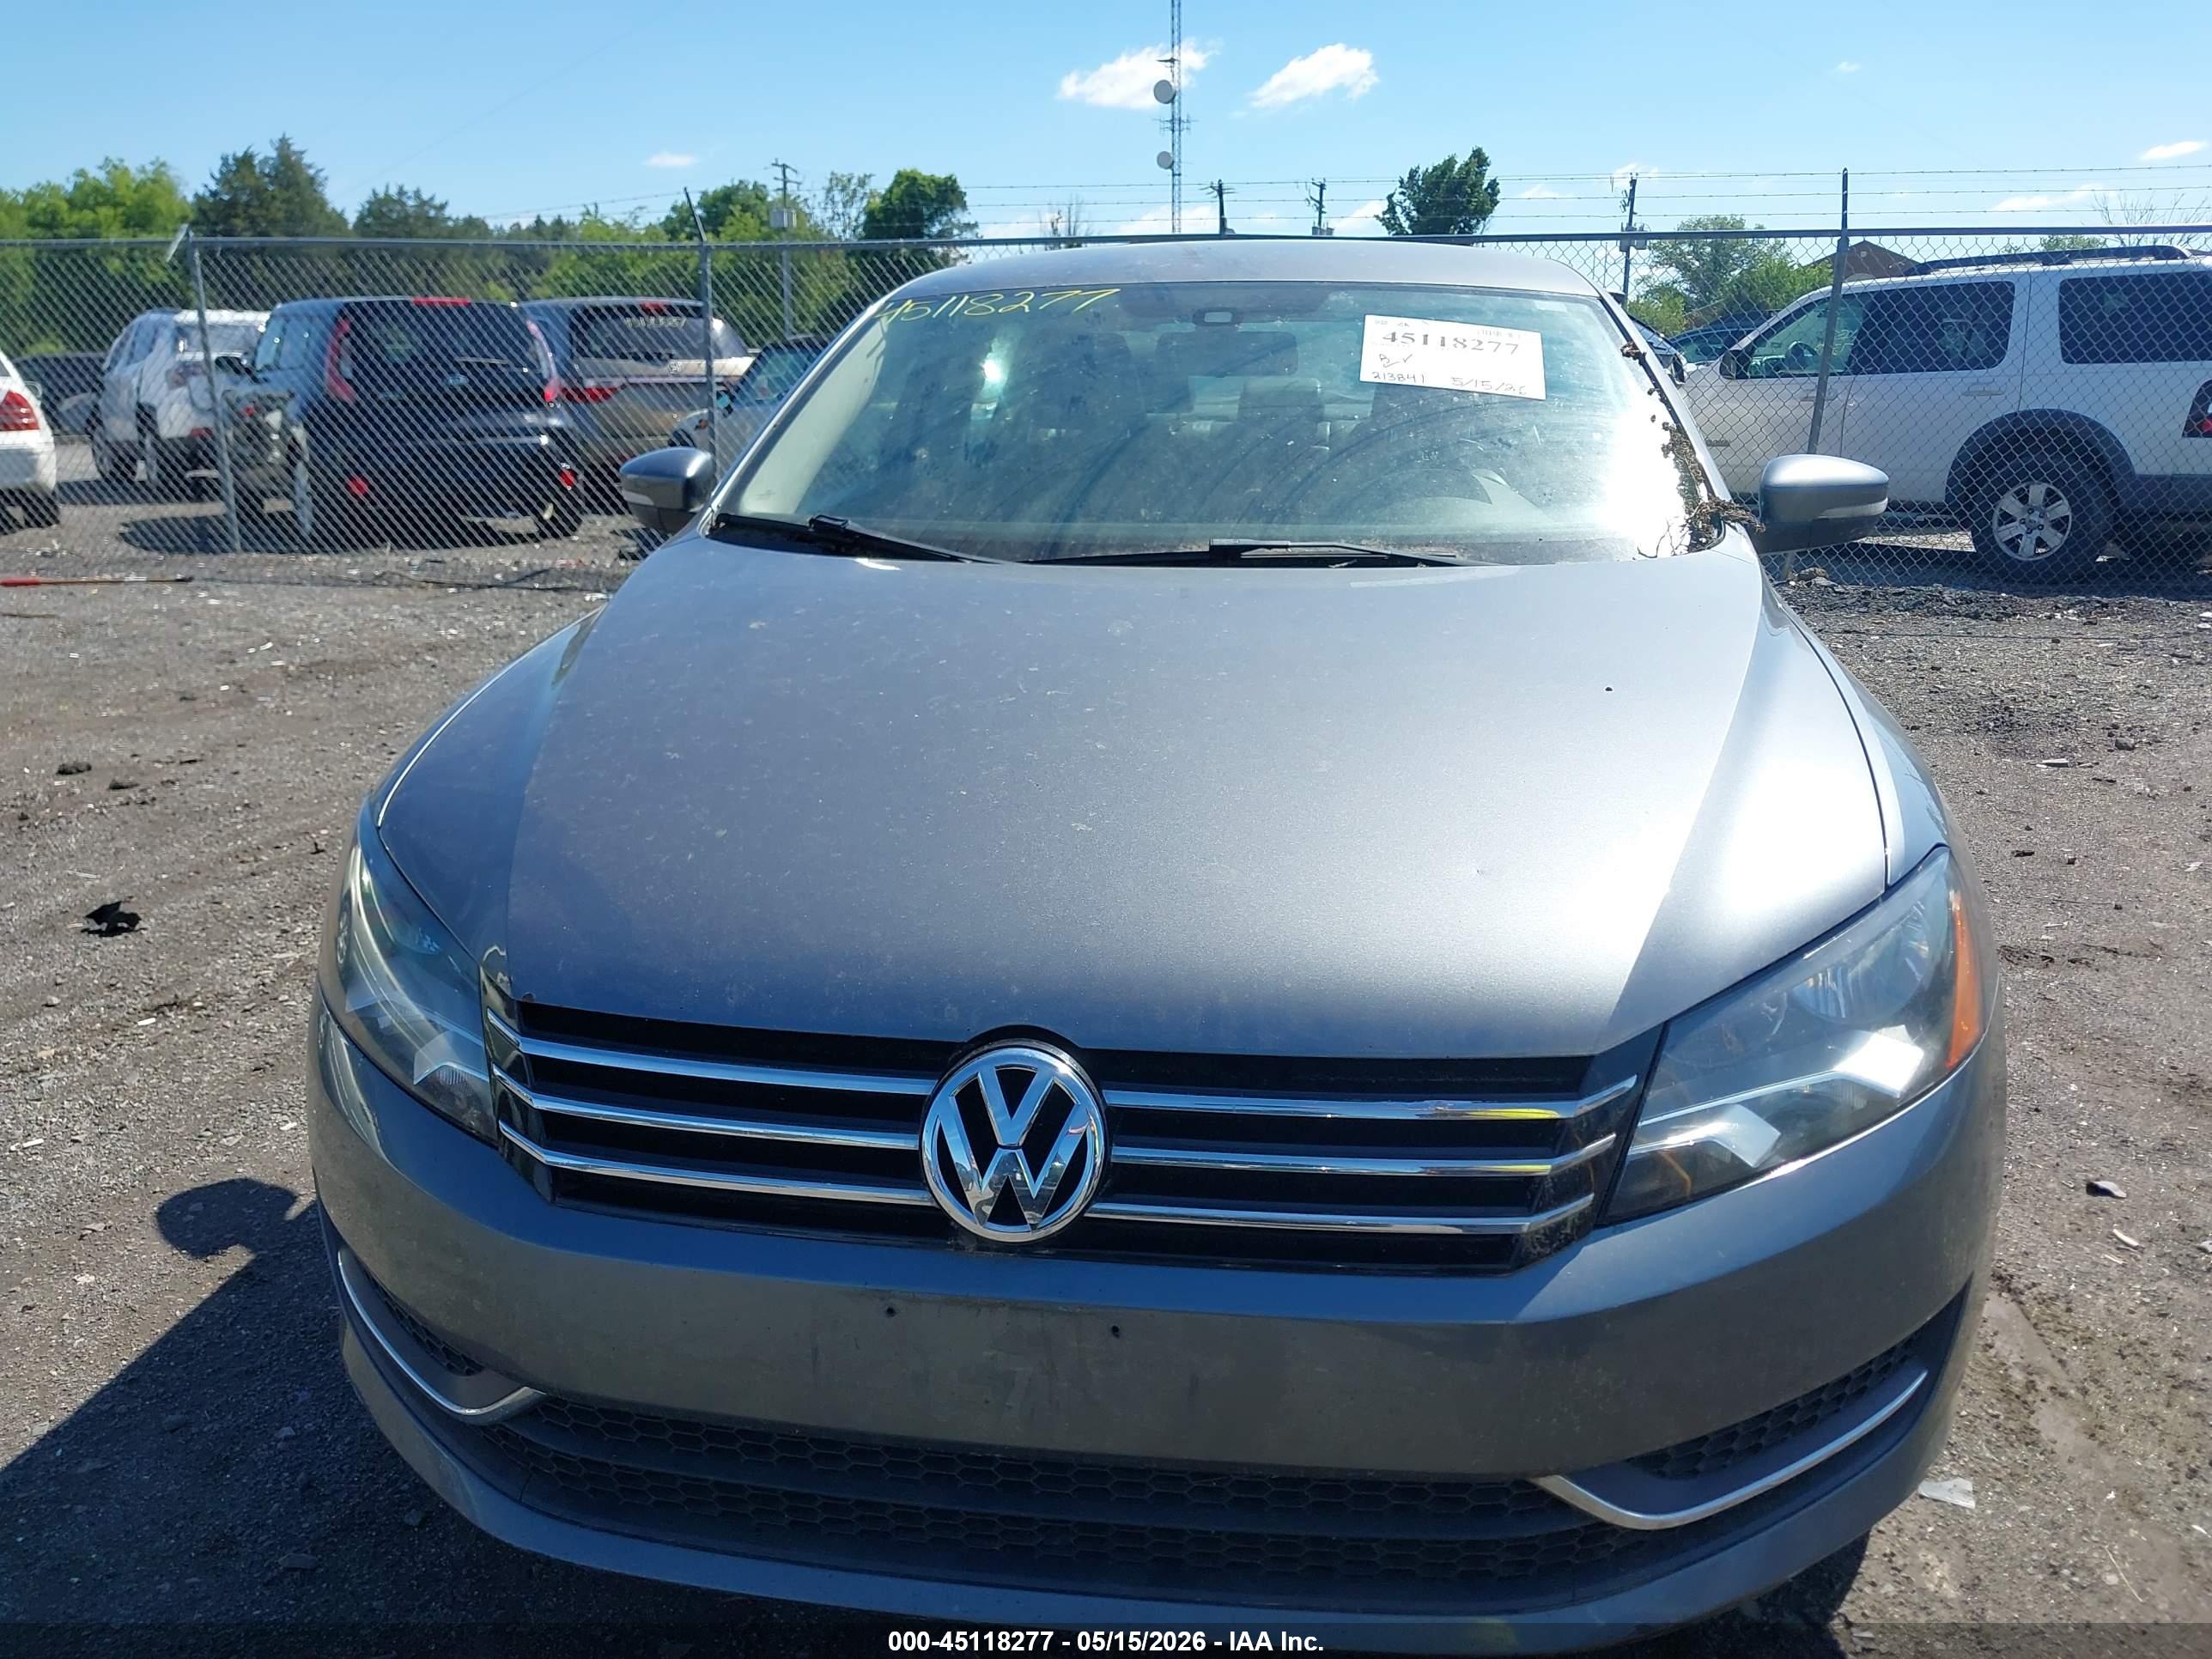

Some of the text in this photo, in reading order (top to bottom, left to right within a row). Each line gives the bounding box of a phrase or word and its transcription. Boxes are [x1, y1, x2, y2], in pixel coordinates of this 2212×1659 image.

[876, 288, 1121, 324] 45118277
[1382, 331, 1518, 355] 45118277
[1372, 371, 1425, 384] 213841
